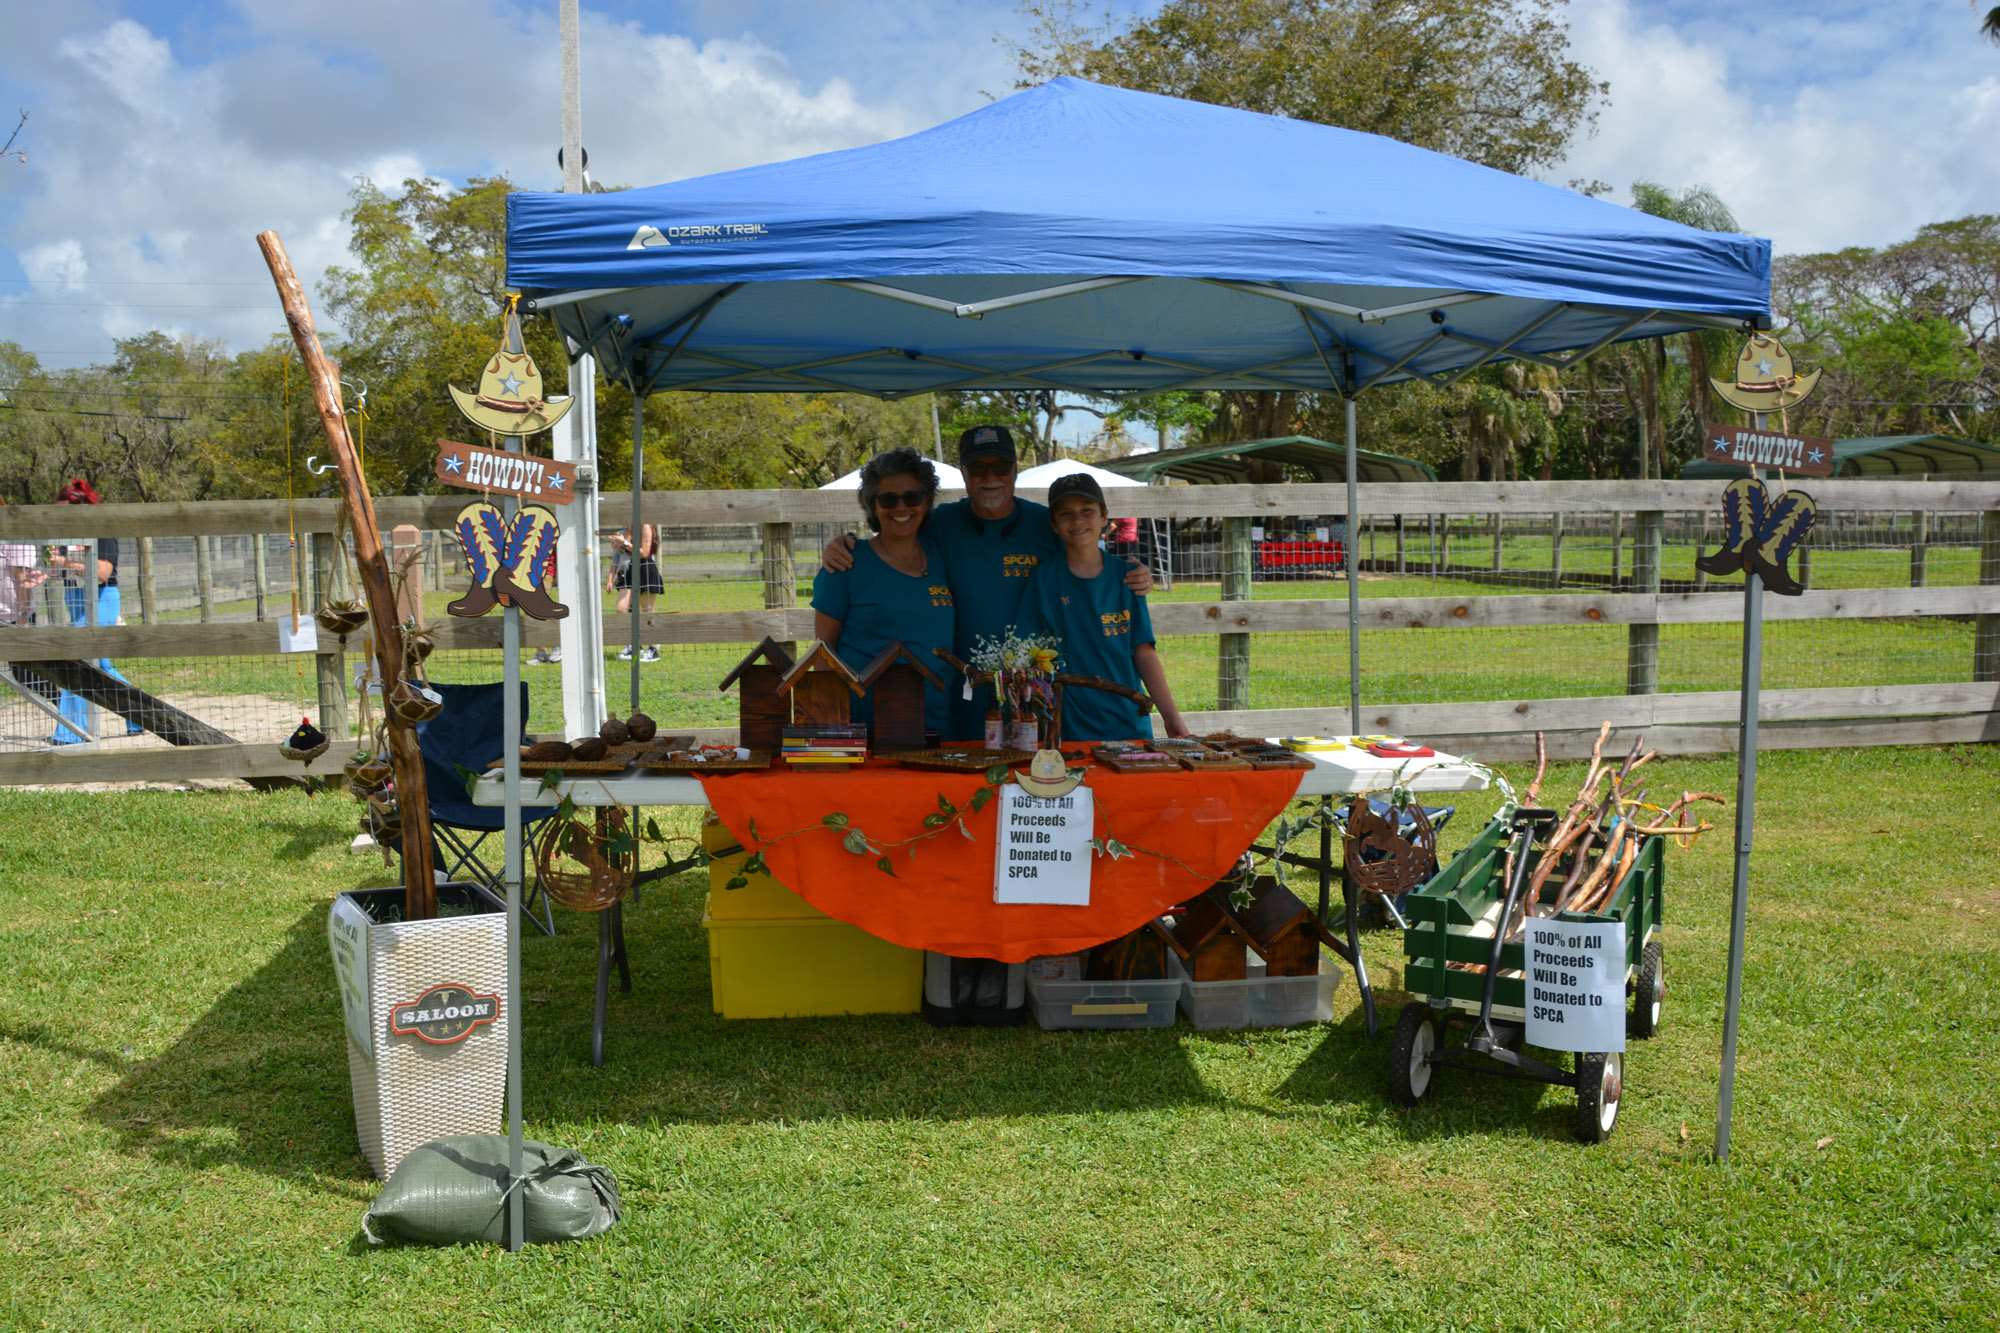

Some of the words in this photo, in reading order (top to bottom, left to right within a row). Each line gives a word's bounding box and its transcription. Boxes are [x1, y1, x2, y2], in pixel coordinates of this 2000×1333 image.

[669, 225, 721, 237] OZARK
[1732, 432, 1804, 468] HOWDY!
[466, 451, 544, 494] HOWDY!
[1003, 555, 1032, 565] SPCA
[1101, 613, 1125, 624] SPCA
[1012, 796, 1042, 809] 100%
[1044, 797, 1057, 809] of
[1058, 797, 1074, 809] All
[1011, 814, 1066, 826] Proceeds
[1010, 831, 1033, 843] Will
[1036, 832, 1051, 843] Be
[1009, 849, 1058, 861] Donated
[1060, 850, 1072, 861] to
[1008, 866, 1038, 878] SPCA
[1533, 930, 1566, 947] 100%
[1568, 936, 1582, 948] of
[1584, 936, 1602, 949] All
[1533, 949, 1594, 968] Proceeds
[1533, 968, 1557, 984] Will
[1560, 972, 1577, 986] Be
[1533, 987, 1586, 1006] Donated
[1589, 994, 1603, 1006] to
[402, 1003, 489, 1024] SALOON
[1533, 1006, 1564, 1023] SPCA
